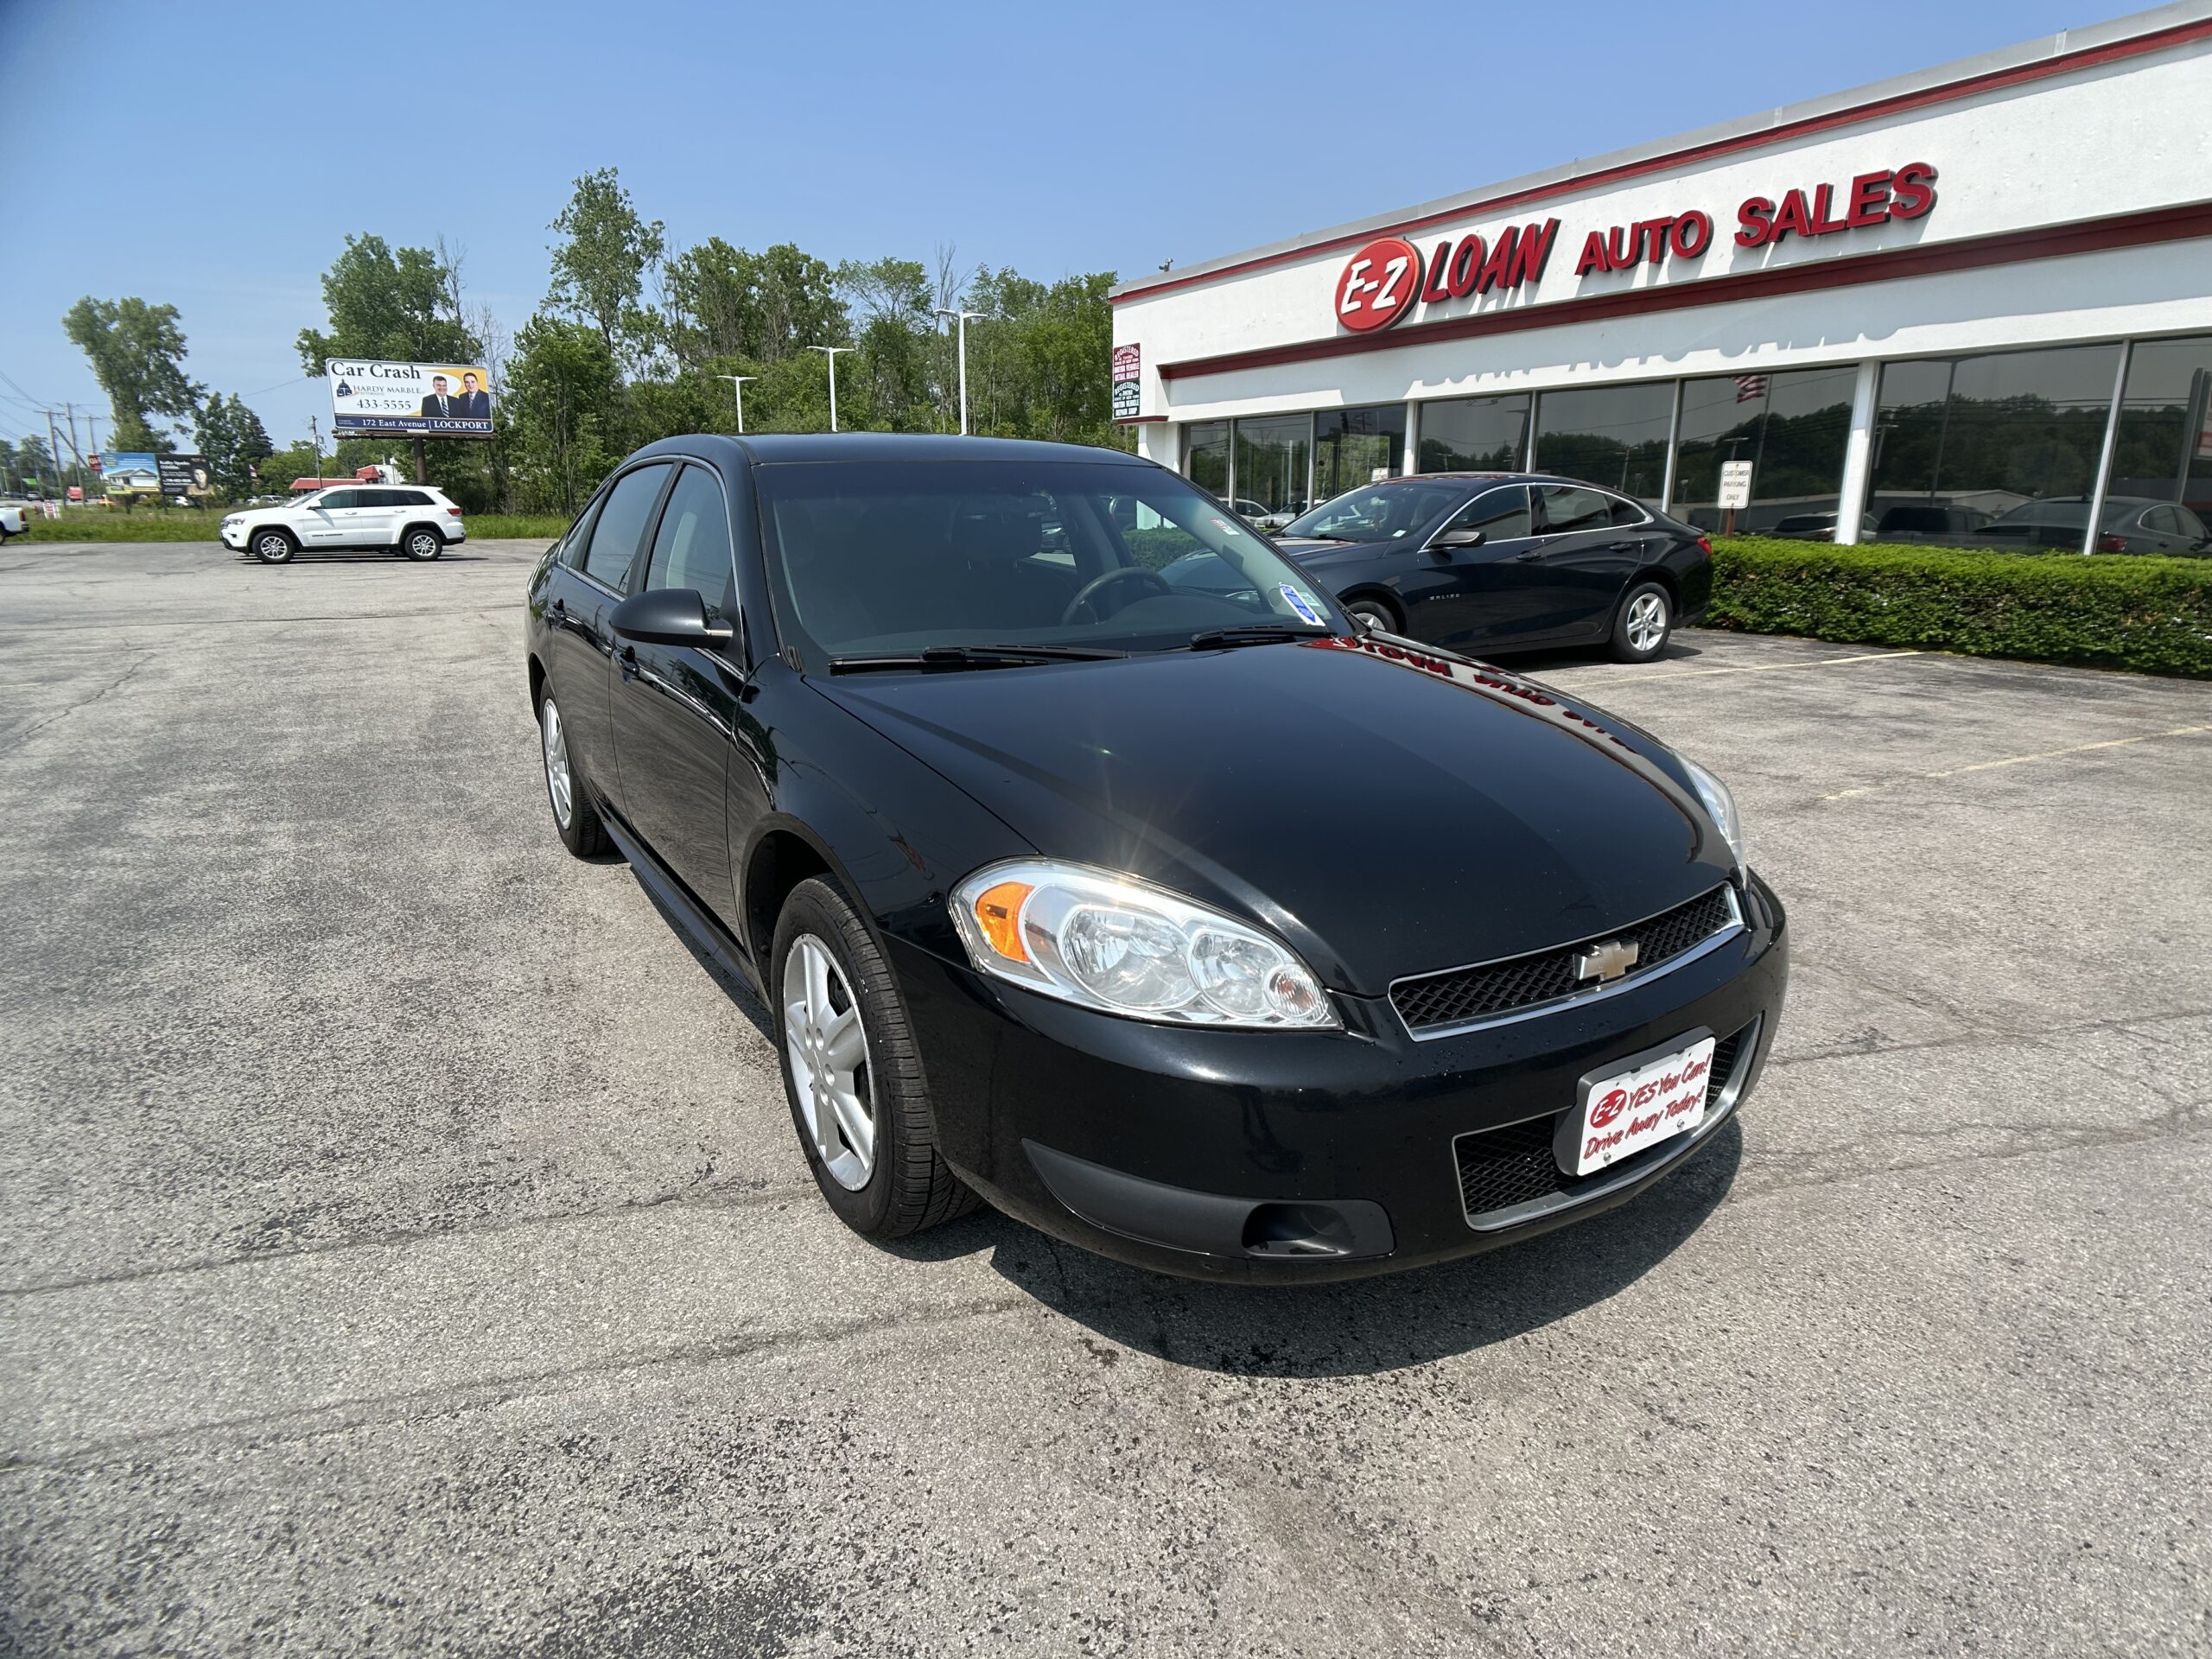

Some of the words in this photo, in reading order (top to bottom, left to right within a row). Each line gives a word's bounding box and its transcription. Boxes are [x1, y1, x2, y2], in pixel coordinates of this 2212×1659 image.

[1341, 255, 1412, 314] E-Z
[1421, 218, 1559, 303] LOAN
[1574, 210, 1713, 276] AUTO
[1734, 162, 1940, 248] SALES
[1115, 346, 1139, 361] REGISTERED
[331, 362, 365, 377] Car
[370, 364, 422, 379] Crash
[1115, 382, 1139, 395] REGISTERED
[357, 398, 411, 410] 433-5555
[378, 418, 397, 427] East
[398, 419, 427, 429] Avenue
[435, 419, 488, 429] LOCKPORT
[1592, 1093, 1625, 1124] E-Z
[1628, 1080, 1660, 1112] YES
[1658, 1072, 1682, 1096] You
[1681, 1052, 1713, 1084] Can!
[1583, 1129, 1624, 1160] Drive
[1624, 1109, 1665, 1140] Away
[1665, 1085, 1705, 1120] Today!
